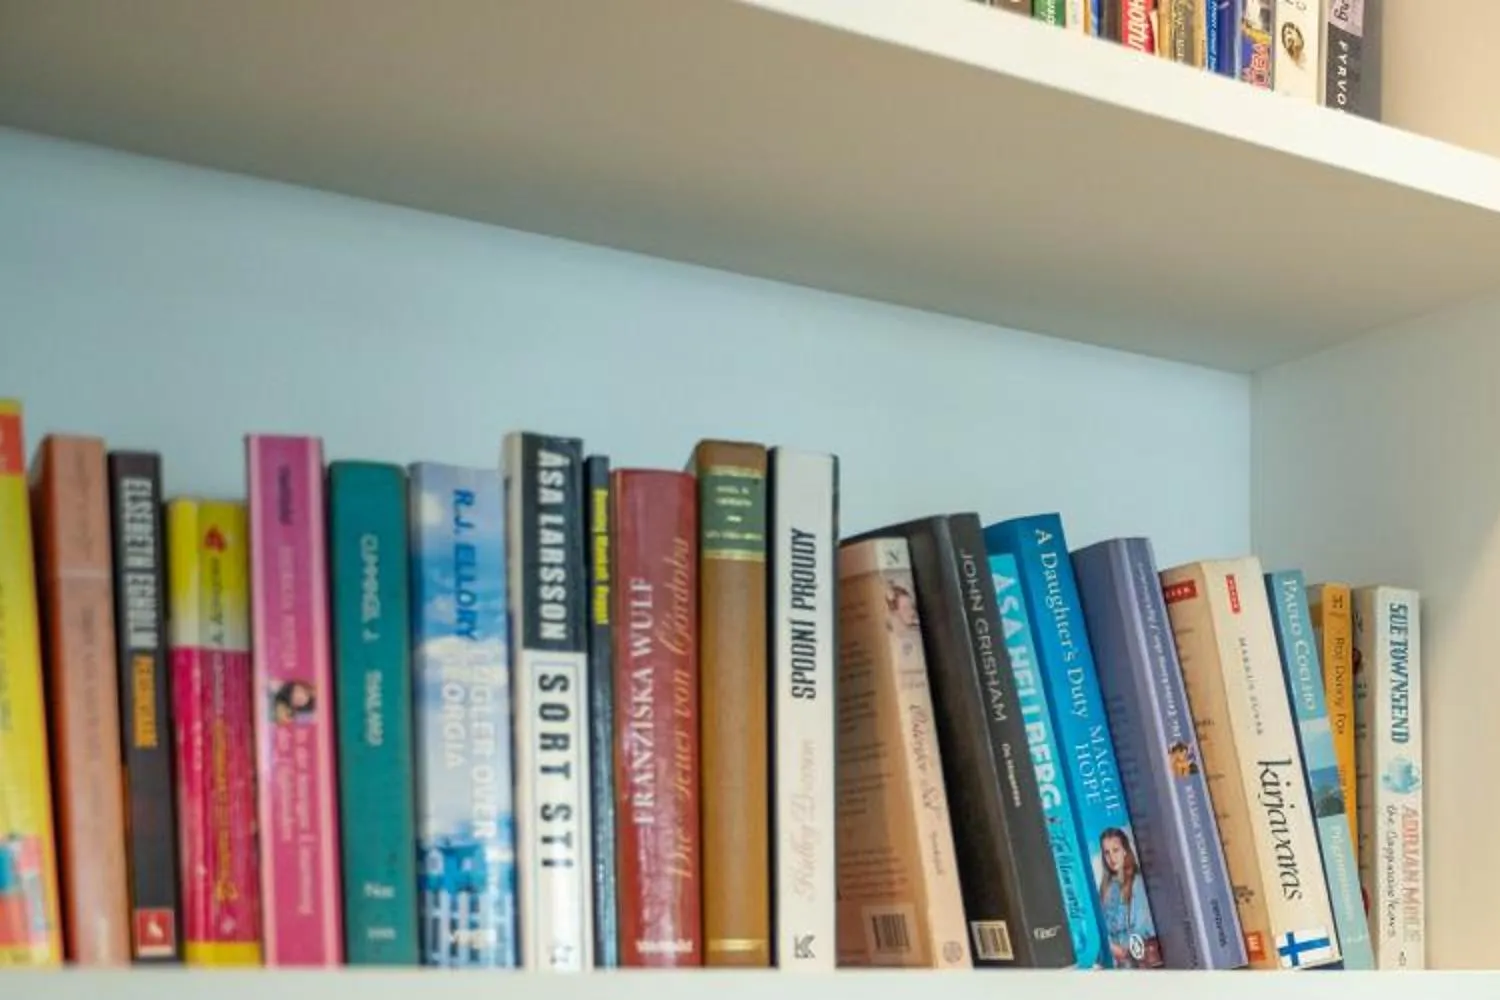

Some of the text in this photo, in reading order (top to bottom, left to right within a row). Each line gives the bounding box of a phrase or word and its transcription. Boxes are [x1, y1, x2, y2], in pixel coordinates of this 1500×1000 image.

[1336, 40, 1349, 113] FYRVO
[122, 477, 159, 649] ELSEBETH EGHOLM
[453, 542, 479, 640] ELLORY
[539, 450, 568, 640] ÅSA LARSSON
[789, 528, 817, 700] SPODNÍ PROUDY
[959, 549, 1007, 722] JOHN GRISHAM
[1035, 527, 1090, 718] A Daughter's Duty
[1282, 579, 1317, 711] PAULO COELHO
[1388, 603, 1411, 744] SUE TOWNSEND
[536, 674, 575, 870] SORT STI
[629, 577, 656, 826] FRANZISKA WULF
[1007, 646, 1063, 809] HELLBERG
[1073, 725, 1121, 816] MAGGIE HOPE
[1335, 712, 1347, 736] Fox
[471, 765, 498, 839] OVER
[1255, 758, 1306, 902] kirjavaras
[1402, 804, 1421, 885] ADRIAN
